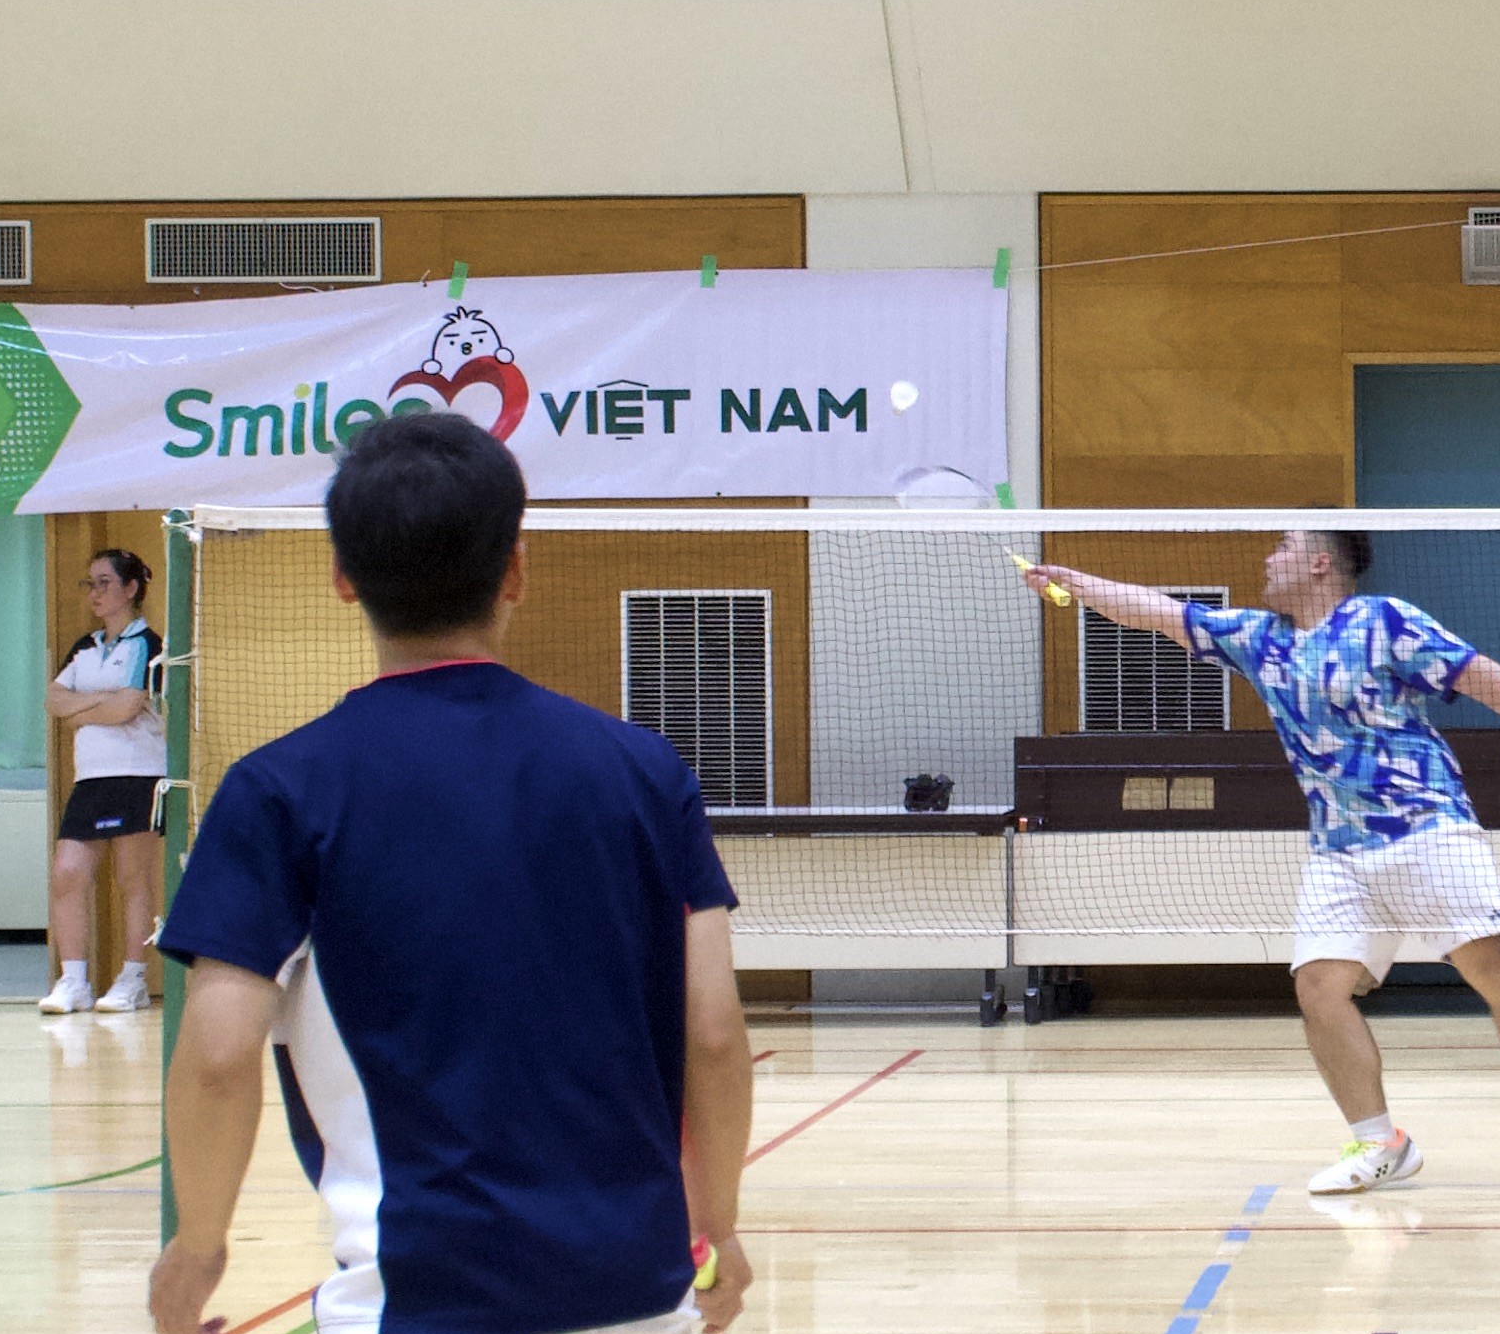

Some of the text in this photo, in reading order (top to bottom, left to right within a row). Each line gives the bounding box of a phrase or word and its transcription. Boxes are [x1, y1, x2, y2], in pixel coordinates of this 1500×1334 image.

[163, 381, 433, 458] Smile
[539, 378, 868, 441] VIỆT NAM
